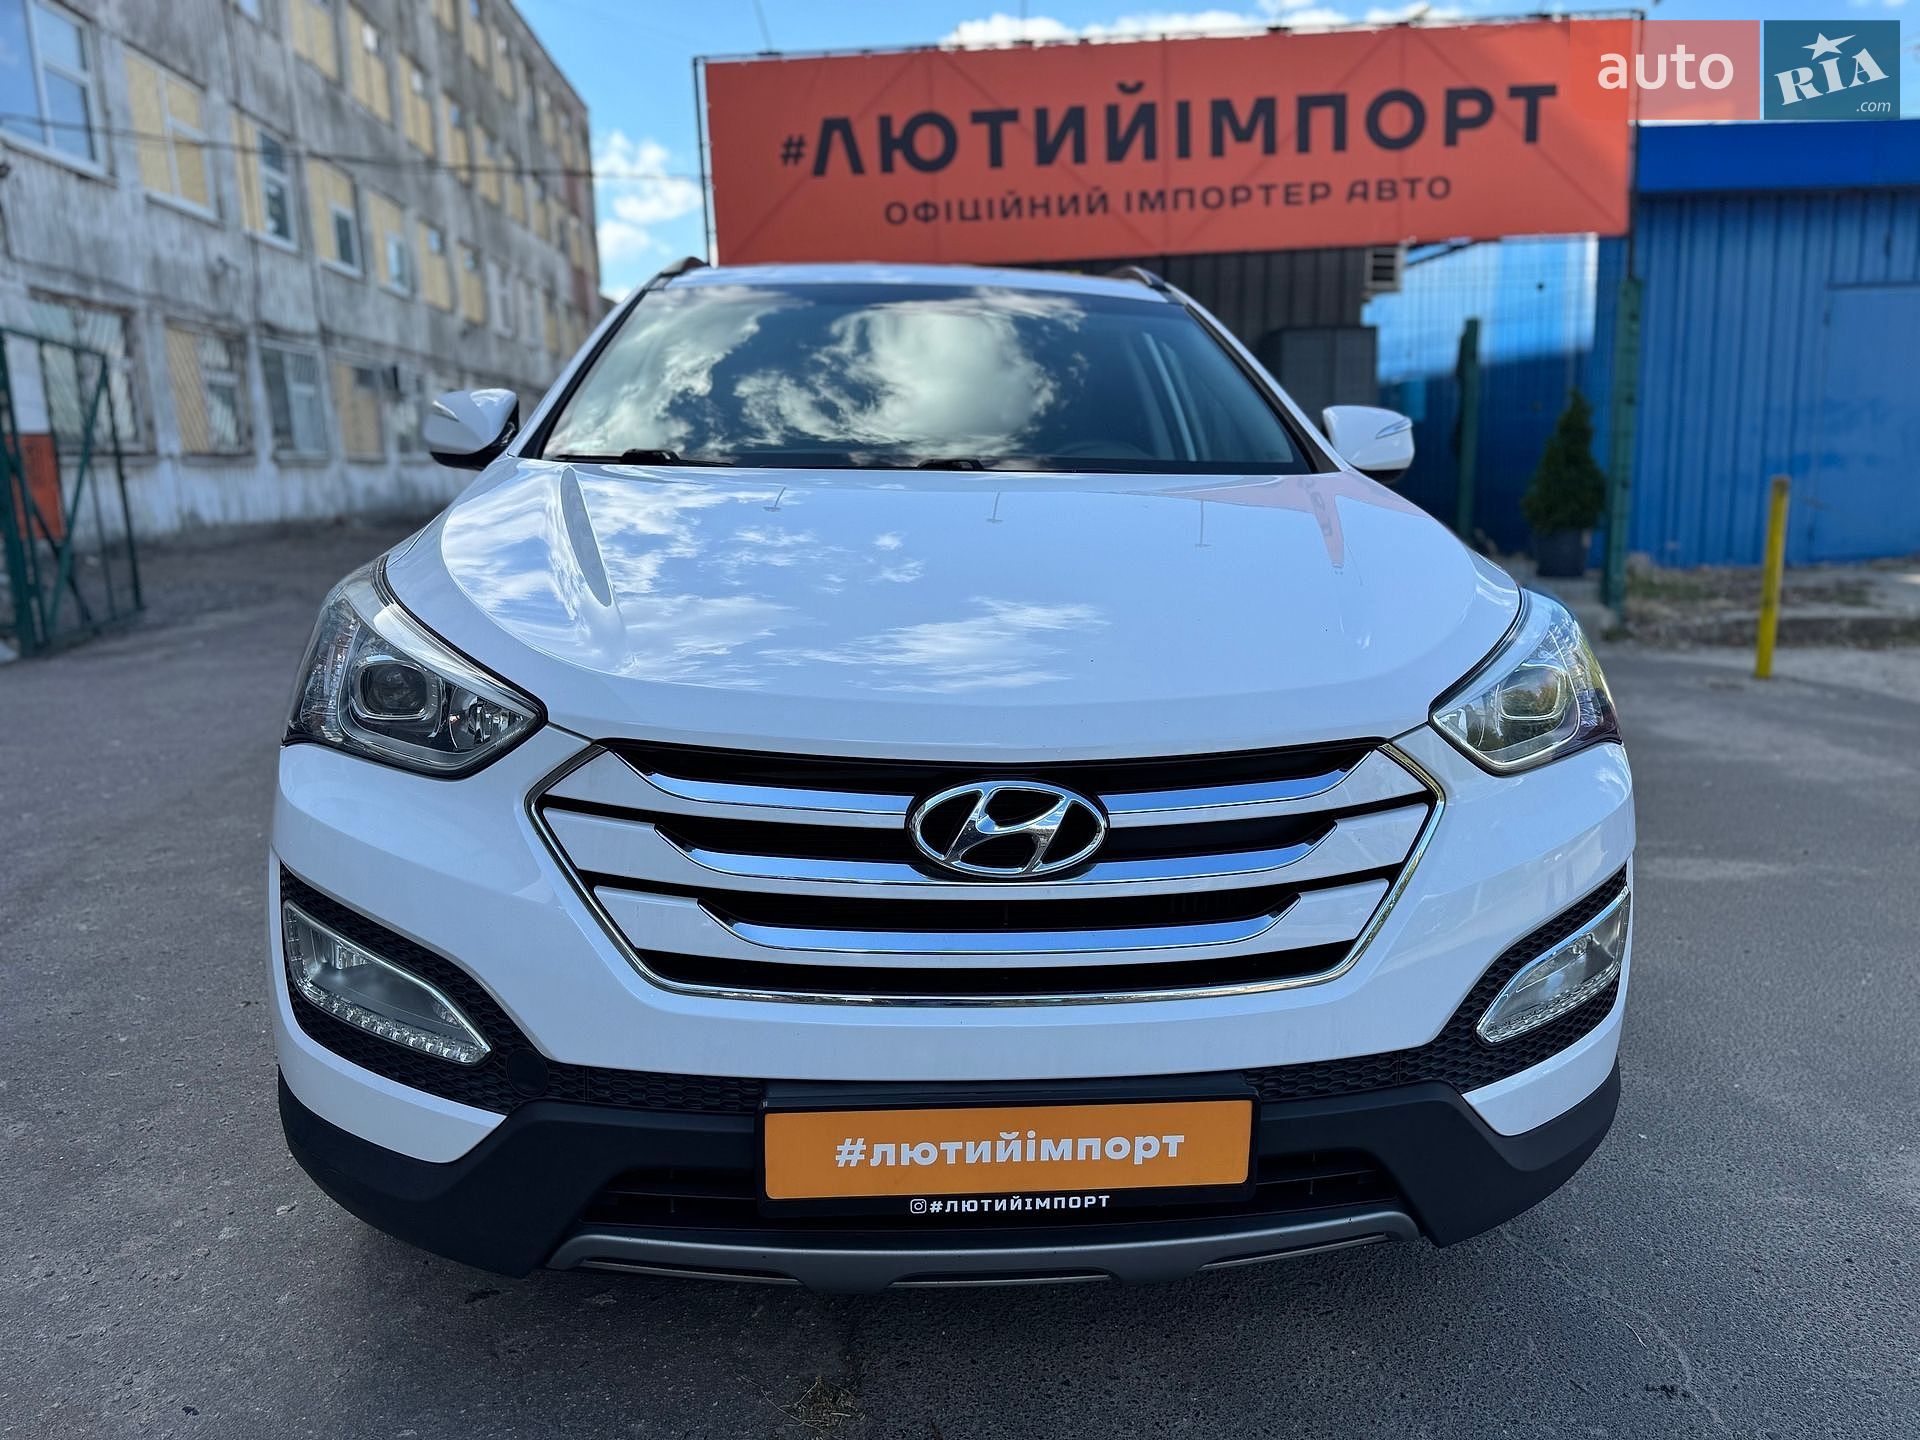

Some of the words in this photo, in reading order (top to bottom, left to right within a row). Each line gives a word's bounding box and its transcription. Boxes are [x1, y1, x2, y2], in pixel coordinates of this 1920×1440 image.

[780, 81, 1558, 177] #ЛЮТИЙІМПОРТ
[884, 186, 1109, 226] ОФІЦІЙНИЙ
[1124, 181, 1333, 214] ІМПОРТЕР
[1346, 175, 1452, 204] АВТО
[834, 1130, 1186, 1168] #лютийімпорт
[929, 1194, 1111, 1214] #ЛЮТИЙІМПОРТ
